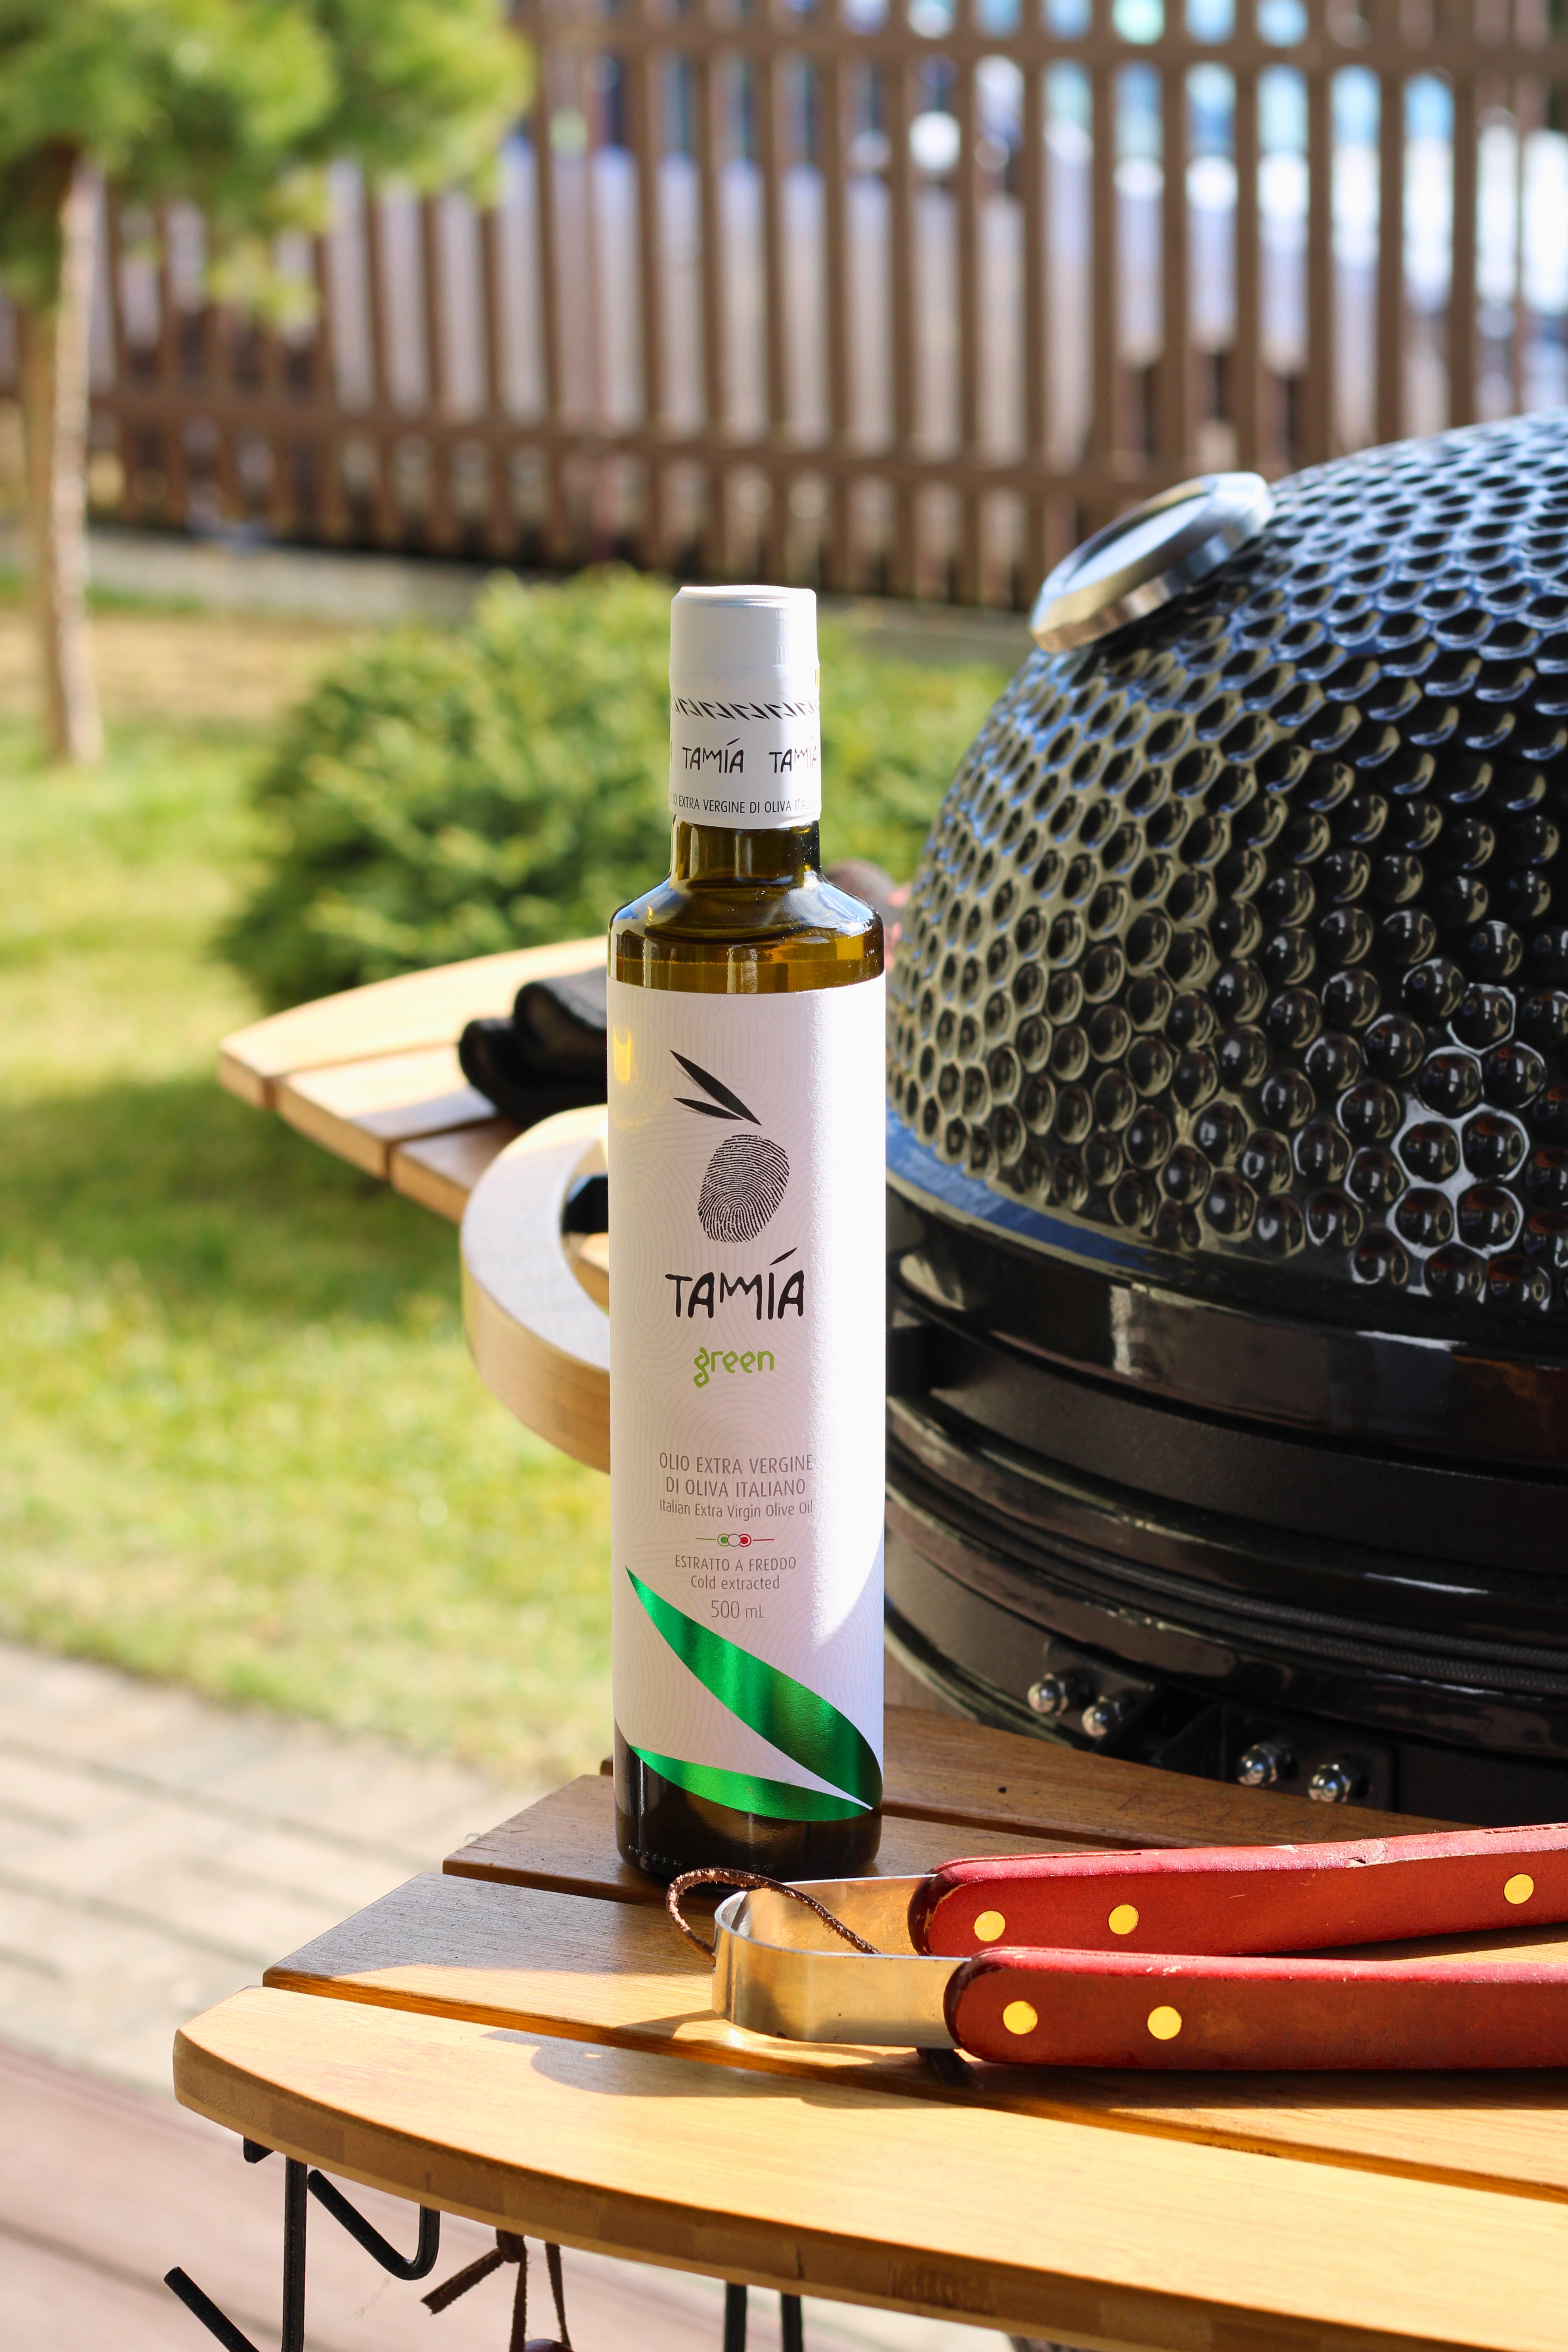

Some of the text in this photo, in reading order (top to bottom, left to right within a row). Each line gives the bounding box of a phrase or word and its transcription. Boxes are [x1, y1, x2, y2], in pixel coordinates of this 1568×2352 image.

[682, 738, 744, 773] TAMÍA
[679, 795, 700, 810] EXTRA
[703, 799, 745, 813] VERGINE
[750, 802, 760, 813] DI
[764, 800, 791, 813] OLIVA
[665, 1247, 804, 1320] TAMÍA
[693, 1347, 774, 1388] green
[660, 1452, 813, 1474] OLIO EXTRA VERGINE
[666, 1477, 805, 1497] DI OLIVA ITALIANO
[660, 1499, 812, 1521] Italian Extra Virgin Olive Oil
[675, 1555, 796, 1571] ESTRATTO A FREDDO
[691, 1575, 779, 1590] Cold extracted
[711, 1600, 739, 1618] 500
